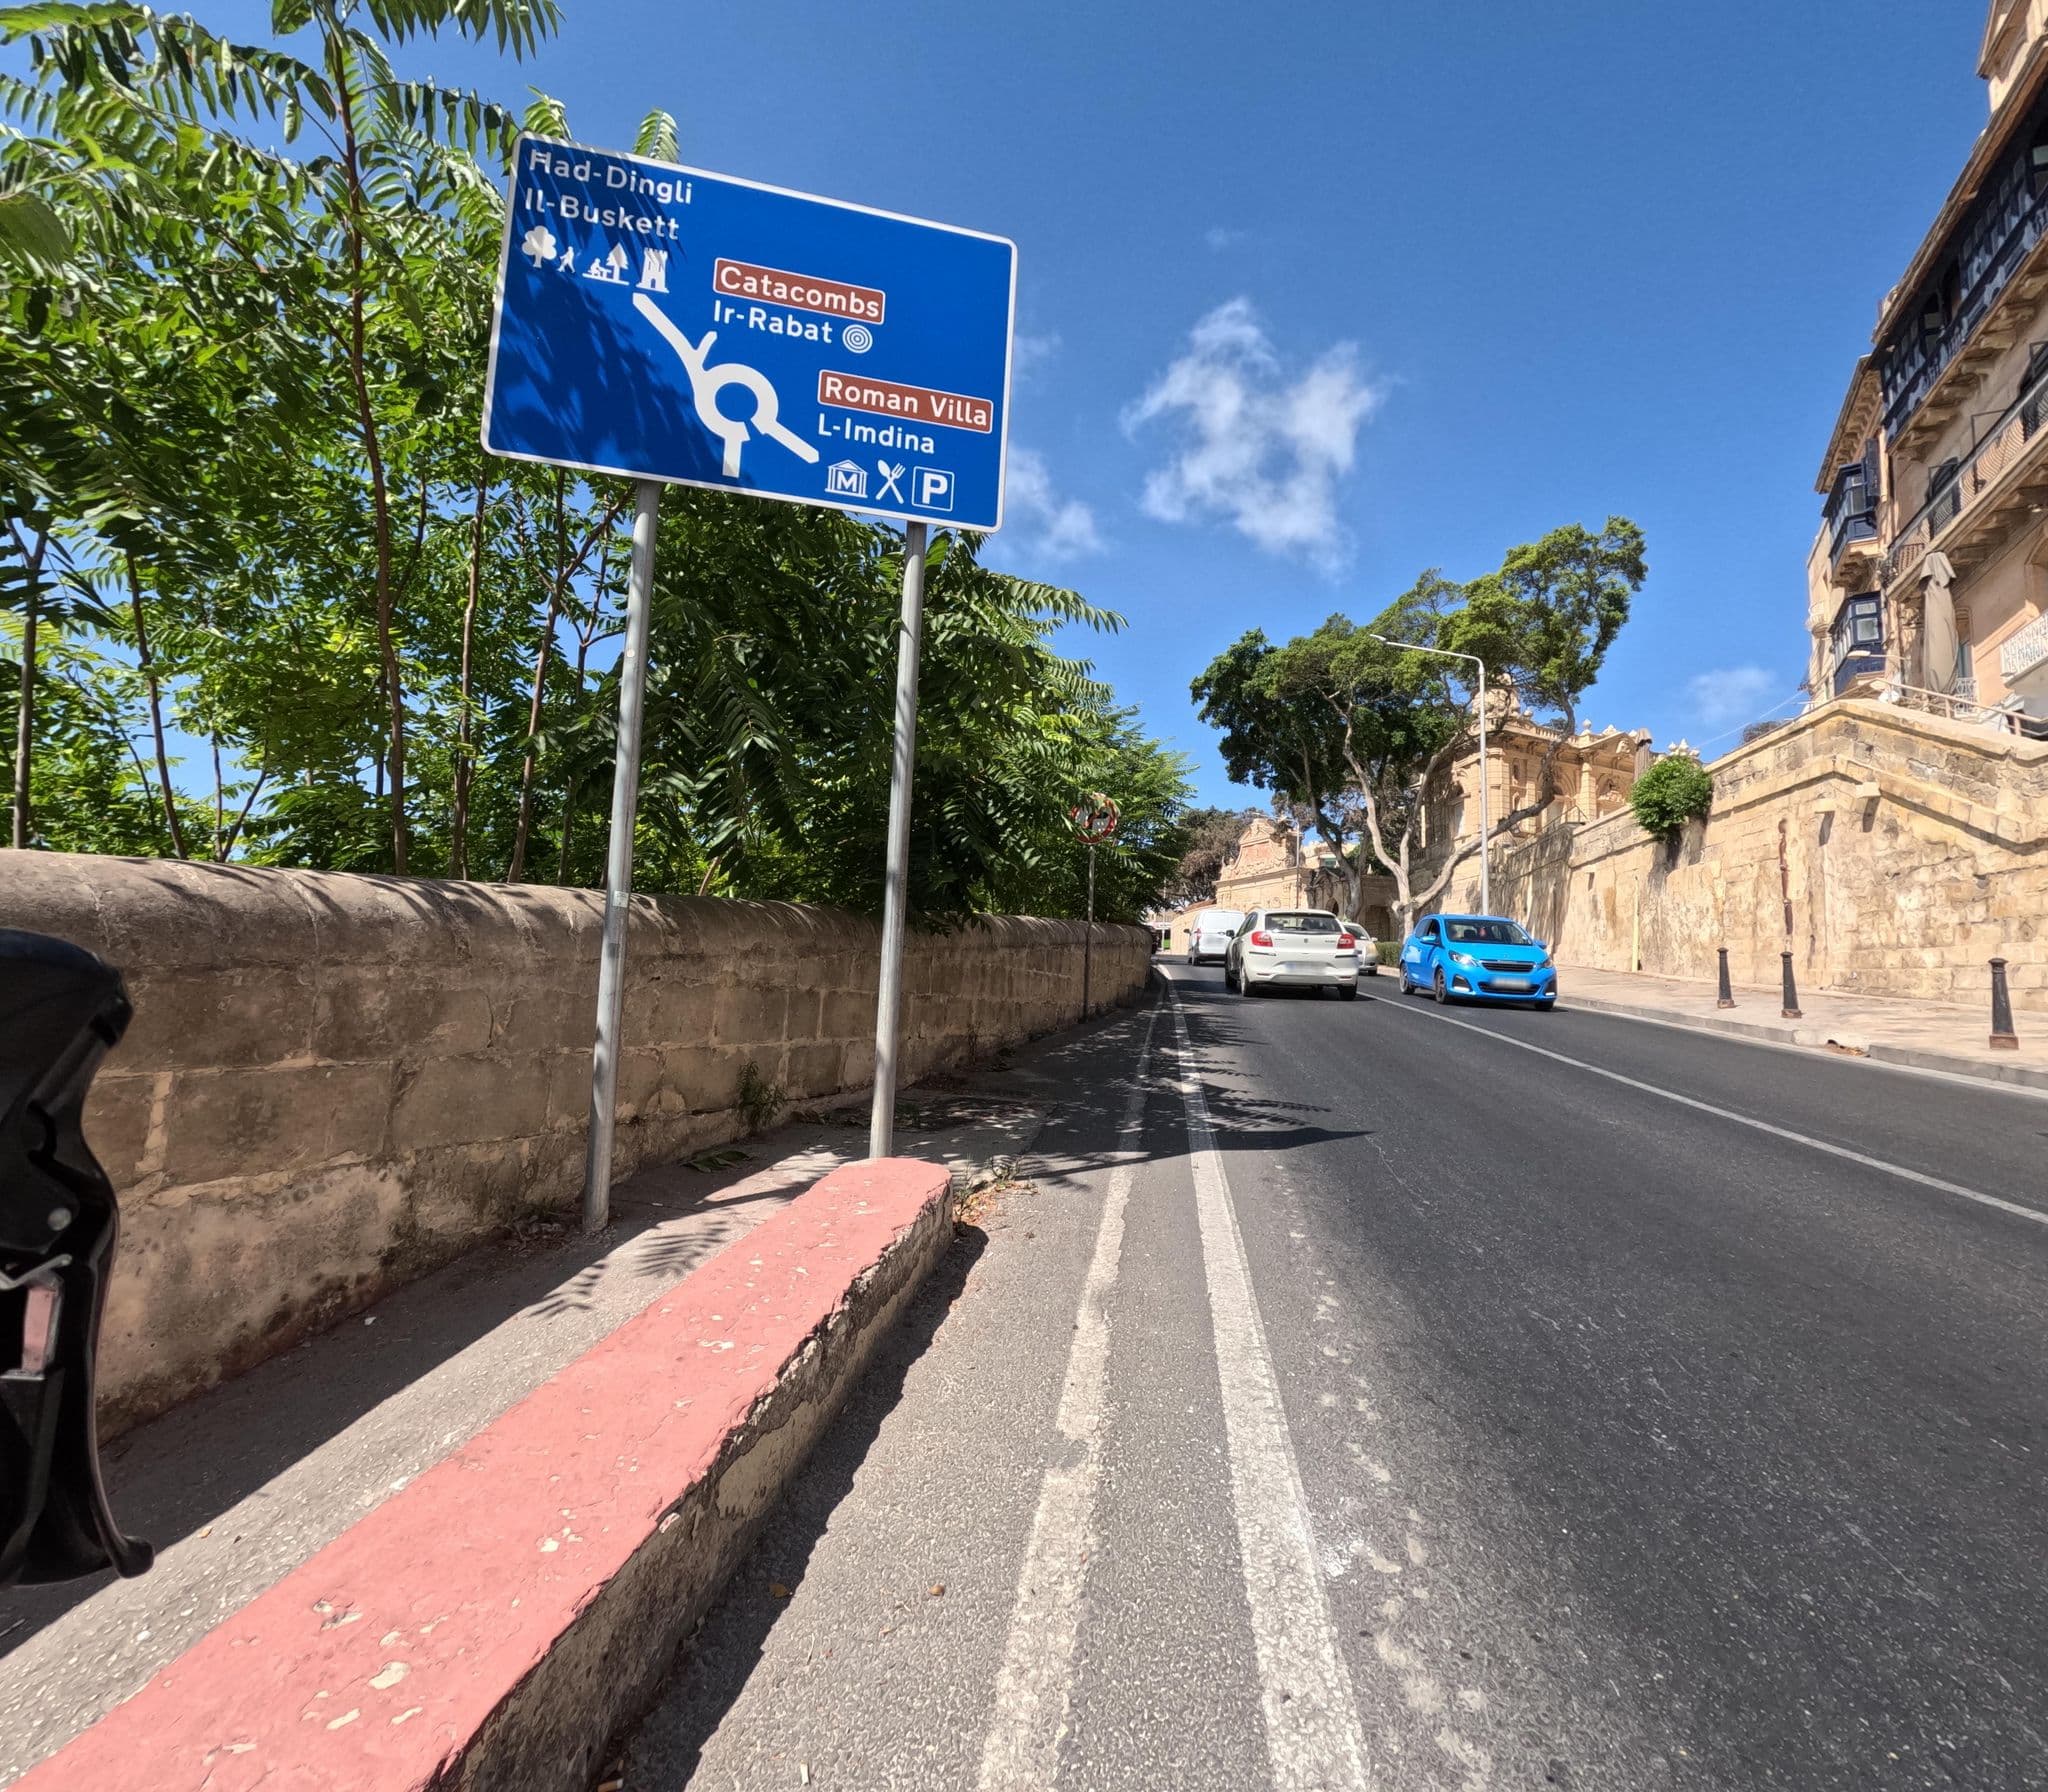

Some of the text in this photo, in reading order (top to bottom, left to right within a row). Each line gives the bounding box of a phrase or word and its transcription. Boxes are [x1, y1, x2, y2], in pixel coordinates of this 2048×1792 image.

[525, 187, 680, 240] Il-Buskett
[720, 266, 880, 318] Catacombs
[714, 300, 833, 344] Ir-Rabat
[825, 376, 987, 426] Roman Villa
[818, 413, 935, 454] L-Imdina
[836, 471, 858, 492] M
[922, 472, 948, 504] P
